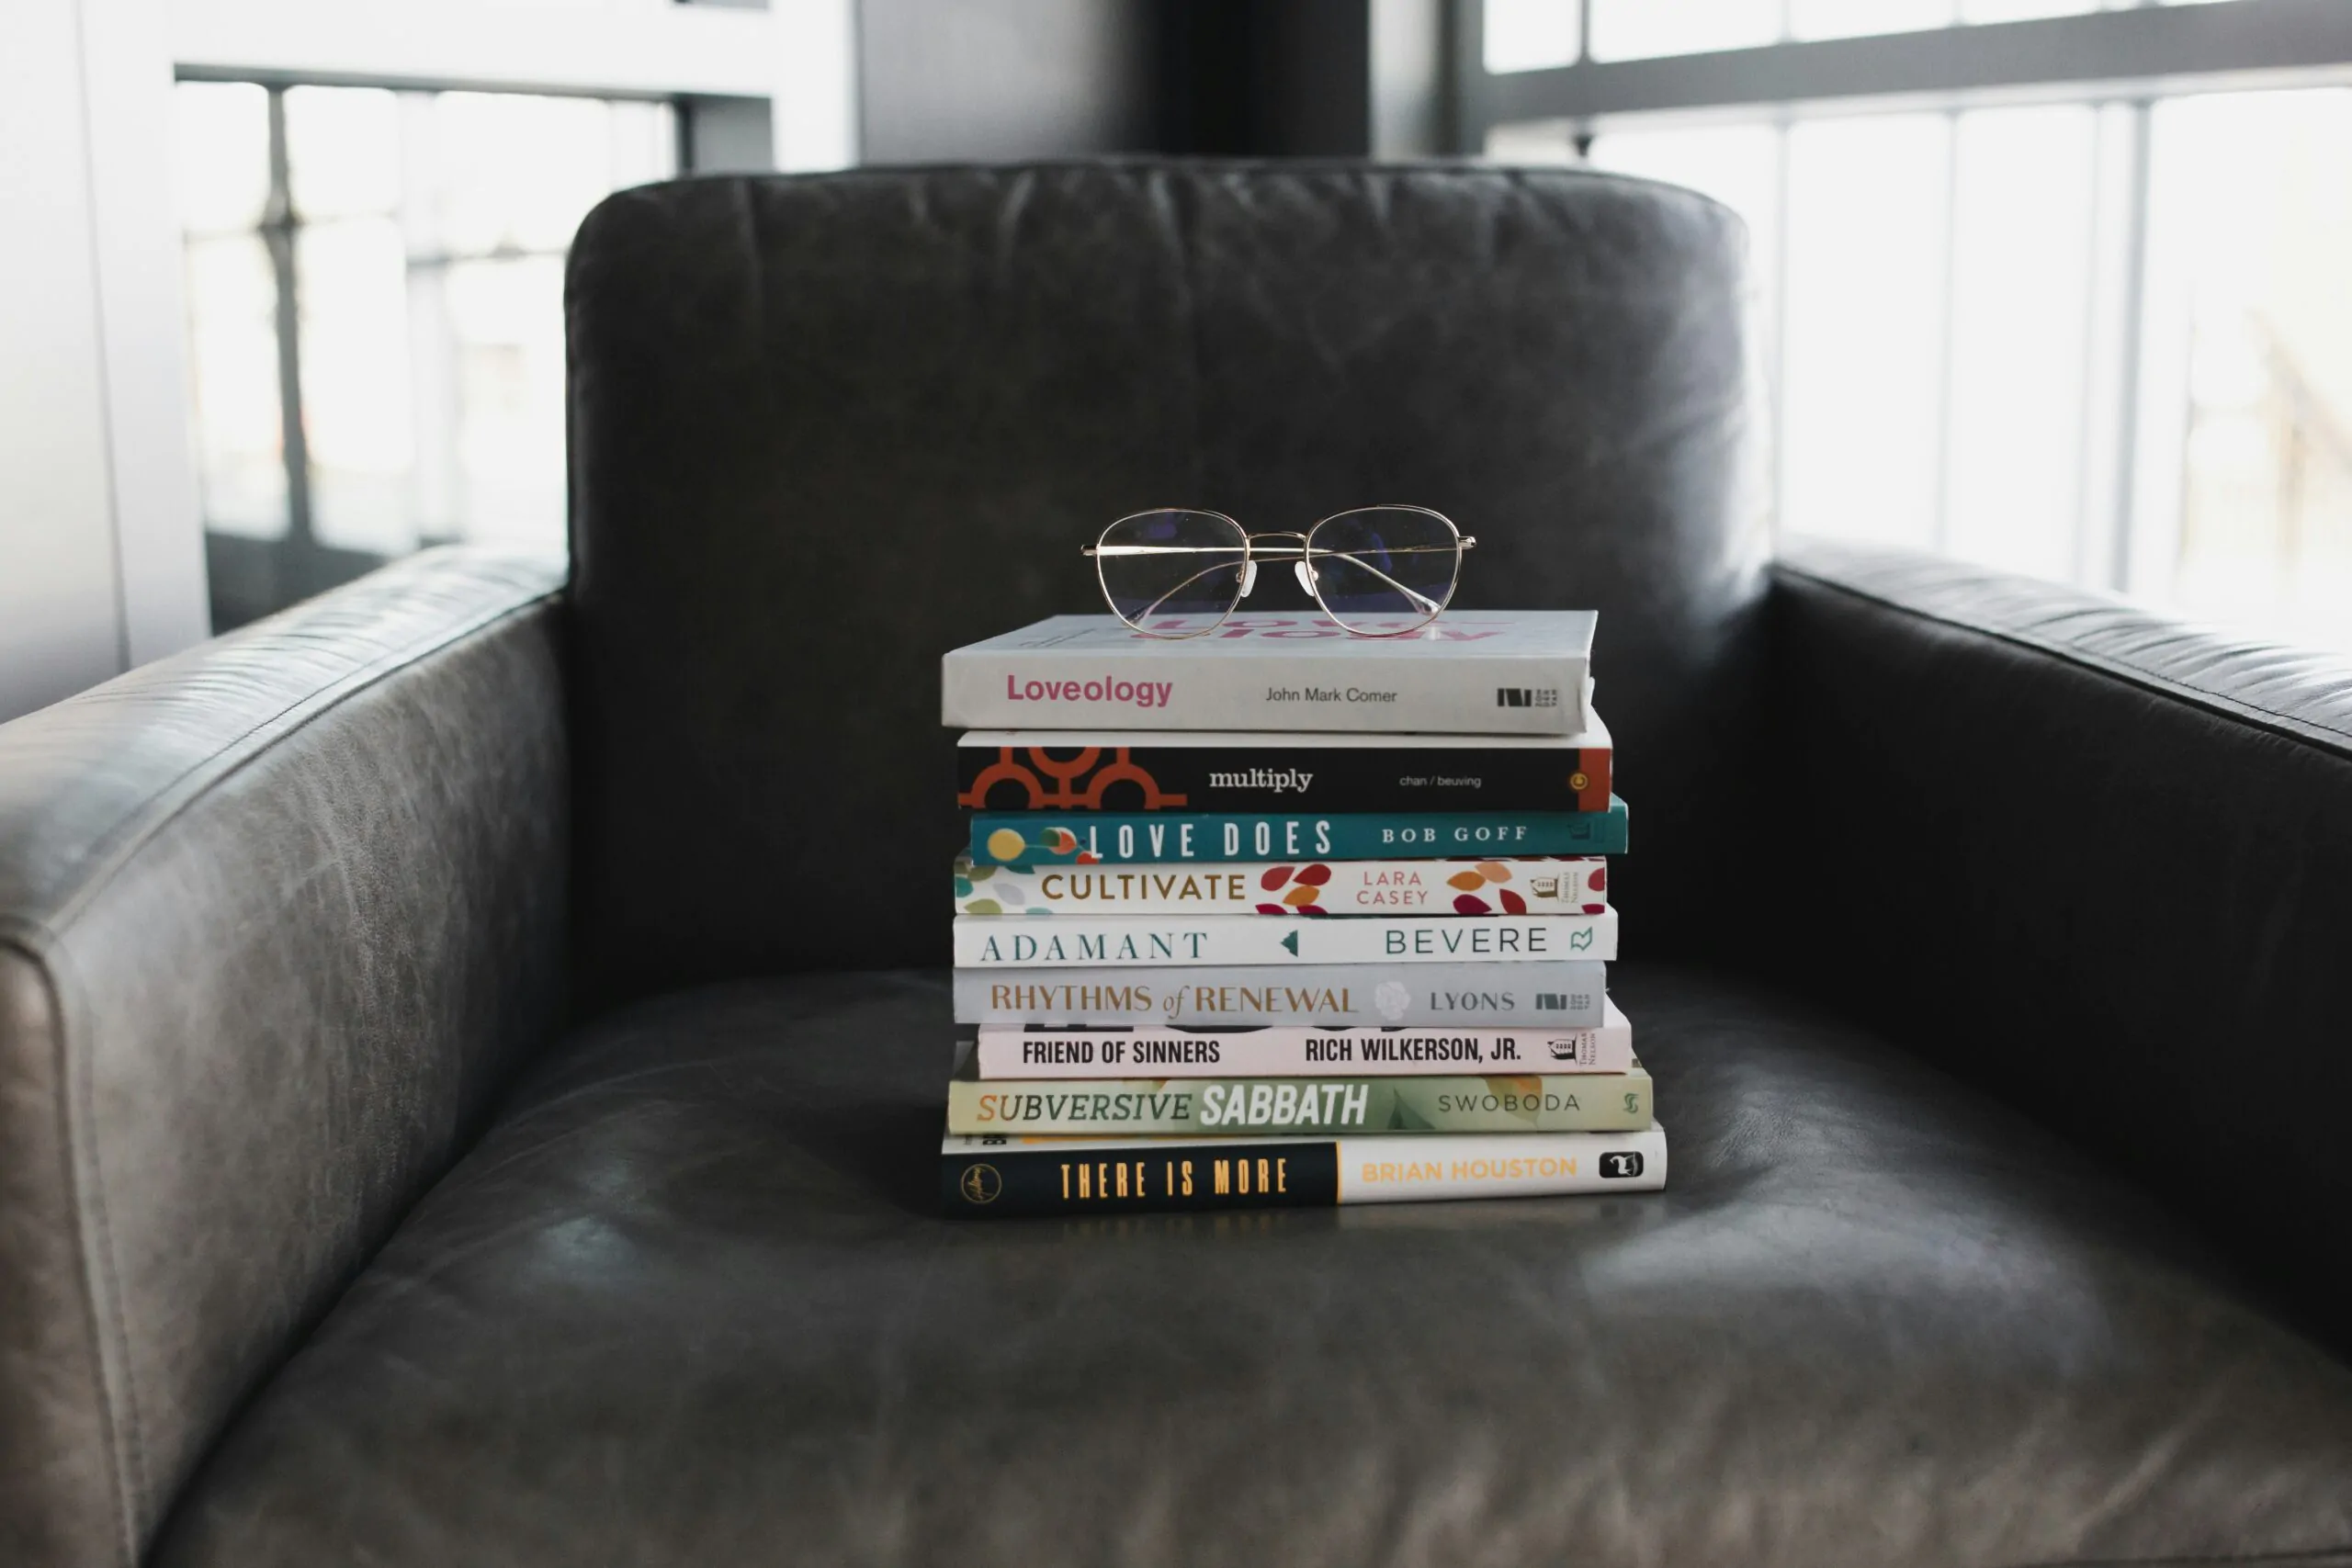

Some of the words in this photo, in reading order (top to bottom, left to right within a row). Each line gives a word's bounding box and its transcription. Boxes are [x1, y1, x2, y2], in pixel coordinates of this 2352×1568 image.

[1007, 674, 1173, 708] Loveology
[1266, 687, 1301, 702] John
[1305, 687, 1341, 702] Mark
[1346, 687, 1397, 703] Comer
[1209, 768, 1314, 794] multiply
[1399, 775, 1428, 786] chan
[1437, 775, 1482, 789] beuving
[1090, 823, 1194, 859] LOVE
[1224, 819, 1331, 856] DOES
[1382, 828, 1436, 843] BOB
[1453, 826, 1527, 841] GOFF
[1041, 874, 1246, 900] CULTIVATE
[1363, 871, 1422, 886] LARA
[1356, 890, 1429, 906] CASEY
[979, 932, 1208, 962] ADAMANT
[1385, 927, 1547, 954] BEVERE
[991, 985, 1152, 1011] RHYTHMS
[1162, 985, 1191, 1021] of
[1195, 987, 1358, 1013] RENEWAL
[1430, 991, 1516, 1011] LYONS
[1023, 1041, 1094, 1064] FRIEND
[1102, 1041, 1126, 1064] OF
[1133, 1040, 1221, 1064] SINNERS
[1306, 1038, 1352, 1062] RICH
[1361, 1037, 1484, 1064] WILKERSON,
[1490, 1037, 1522, 1061] JR.
[977, 1092, 1193, 1122] SUBVERSIVE
[1200, 1083, 1369, 1126] SABBATH
[1438, 1093, 1581, 1112] SWOBODA
[1060, 1161, 1147, 1200] THERE
[1167, 1160, 1193, 1196] IS
[1214, 1157, 1287, 1194] MORE
[1361, 1162, 1443, 1184] BRIAN
[1451, 1156, 1578, 1181] HOUSTON
